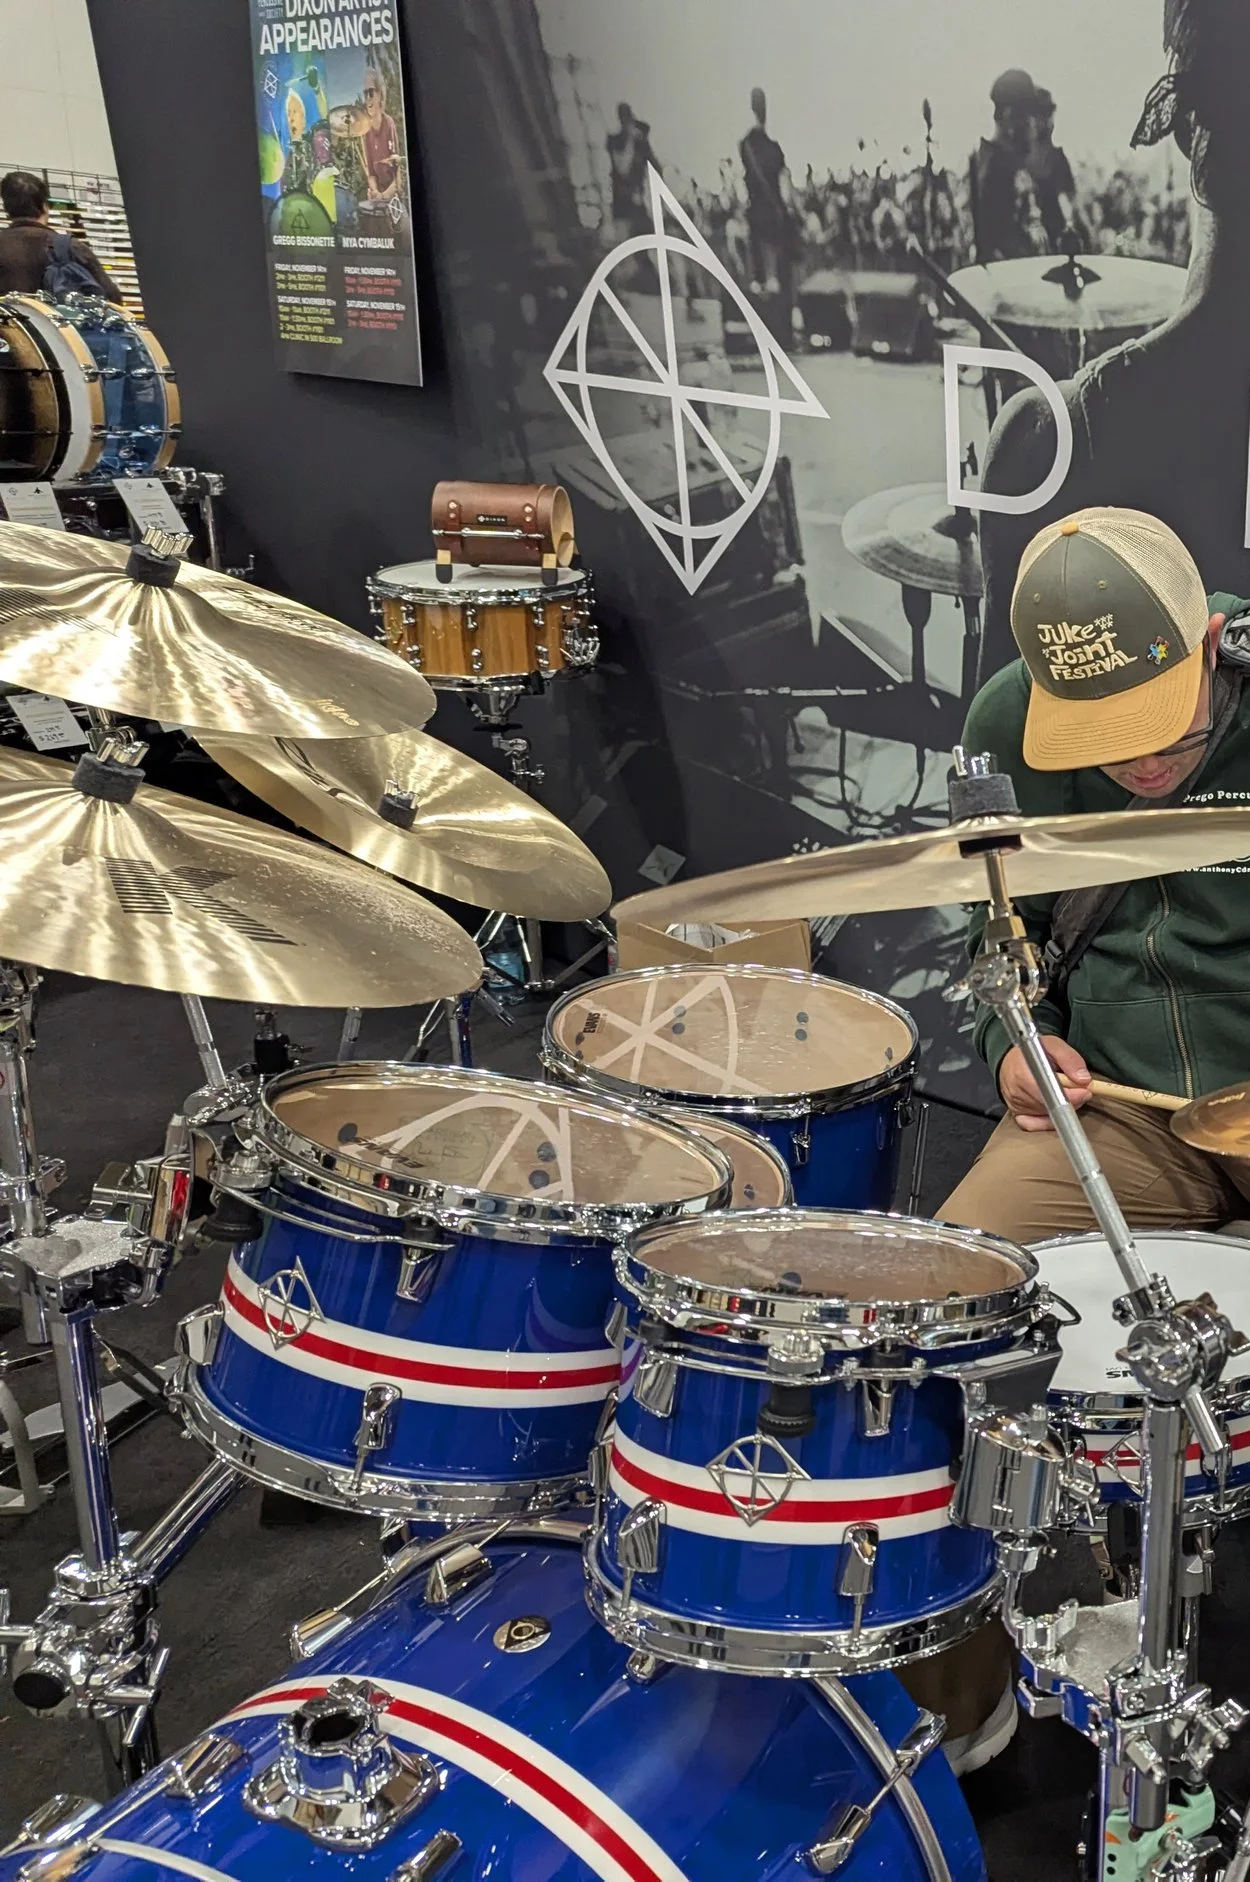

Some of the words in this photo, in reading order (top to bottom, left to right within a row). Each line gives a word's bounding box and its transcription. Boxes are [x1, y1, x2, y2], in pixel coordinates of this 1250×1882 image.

[259, 9, 394, 55] APPEARANCES
[273, 235, 296, 246] GREGG
[343, 237, 359, 249] MYA
[1049, 650, 1139, 681] FESTIVAL
[582, 1012, 601, 1034] EVANS
